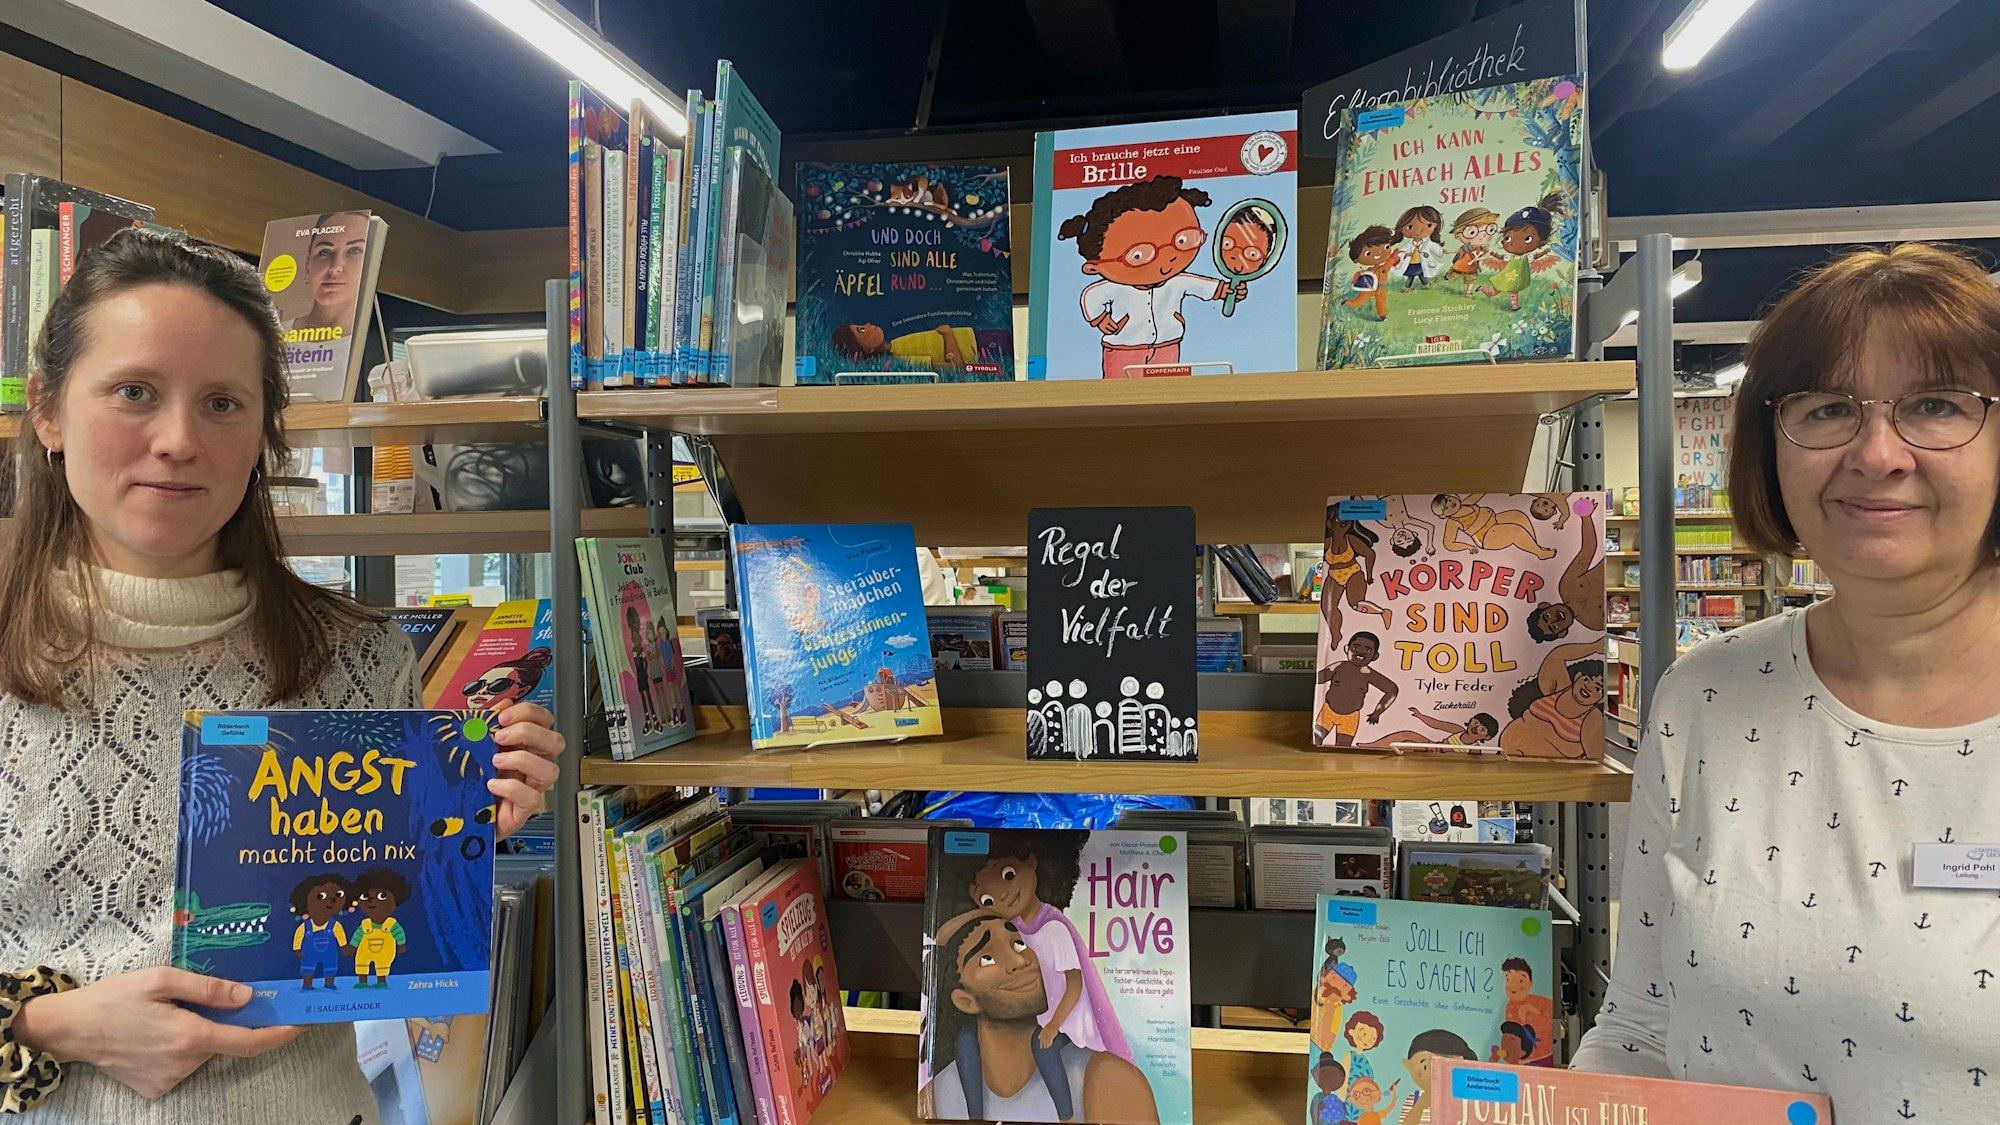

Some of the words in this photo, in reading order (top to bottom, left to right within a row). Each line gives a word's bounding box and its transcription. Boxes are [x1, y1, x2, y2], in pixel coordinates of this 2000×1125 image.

[1070, 153, 1088, 163] Ich
[1092, 150, 1139, 162] brauche
[1142, 146, 1170, 159] jetzt
[1173, 144, 1201, 155] eine
[1392, 139, 1424, 161] ICH
[1437, 128, 1485, 150] KANN
[1082, 163, 1147, 184] Brille
[1463, 150, 1543, 181] ALLES
[653, 166, 662, 208] Rassismus
[1439, 186, 1485, 204] SEIN!
[652, 212, 660, 222] ist
[9, 198, 20, 266] artgerecht
[296, 228, 310, 237] EVA
[311, 225, 346, 236] PLACZEK
[871, 228, 899, 244] UND
[906, 228, 941, 245] DOCH
[62, 214, 72, 275] SCHWANGER
[890, 250, 920, 268] SIND
[926, 252, 957, 269] ALLE
[834, 269, 884, 296] ÄPFEL
[891, 273, 926, 290] RUND
[1408, 306, 1440, 316] Frances
[1442, 303, 1476, 314] Stickley
[1413, 316, 1429, 325] Lucy
[1432, 312, 1469, 323] Fleming
[1038, 523, 1123, 588] Regal
[624, 563, 643, 575] Club
[1380, 557, 1544, 603] KÖRPER
[1090, 568, 1138, 598] der
[1406, 602, 1508, 633] SIND
[1061, 605, 1173, 658] Vielfalt
[810, 646, 857, 676] junge
[1279, 660, 1314, 670] SPIELE
[1394, 640, 1517, 673] TOLL
[1414, 678, 1450, 693] Tyler
[1454, 679, 1495, 692] Feder
[1433, 700, 1476, 710] Zuckersüß
[248, 749, 417, 802] ANGST
[270, 797, 384, 837] haben
[238, 839, 314, 865] macht
[322, 840, 376, 863] doch
[384, 841, 416, 860] nix
[1943, 864, 1970, 872] Ingrid
[1087, 857, 1174, 909] Hair
[622, 900, 630, 923] ganze
[781, 898, 812, 945] SPIELZEUG
[729, 925, 737, 938] ALLE
[750, 937, 758, 948] FÜR
[1406, 922, 1447, 953] SOLL
[1459, 930, 1484, 956] ICH
[731, 938, 739, 952] FÜR
[1103, 967, 1114, 975] Eine
[1115, 967, 1158, 976] herzerwärmende
[1159, 968, 1175, 976] Papa-
[1114, 977, 1164, 986] Tochter-Geschichte,
[1387, 960, 1407, 989] ES
[408, 980, 433, 990] Zehra
[435, 979, 458, 988] Hicks
[647, 970, 657, 1002] FLORIAN
[737, 969, 749, 1002] KLEIDUNG
[756, 968, 768, 1000] SPIELZEUG
[1161, 988, 1174, 996] geht
[317, 1002, 381, 1013] SAUERLÄNDER
[605, 969, 616, 1024] KUNTERBUNTE
[1372, 997, 1388, 1005] Eine
[1394, 996, 1430, 1009] Geschichte
[1434, 1002, 1448, 1010] über
[609, 1026, 617, 1048] MEINE
[749, 1031, 758, 1060] Hoffmann
[769, 1028, 779, 1055] Hoffmann
[1466, 1076, 1500, 1084] Bilderbuch
[1466, 1083, 1500, 1092] Anderssein
[1565, 1106, 1590, 1125] IST
[1600, 1102, 1648, 1125] EINE
